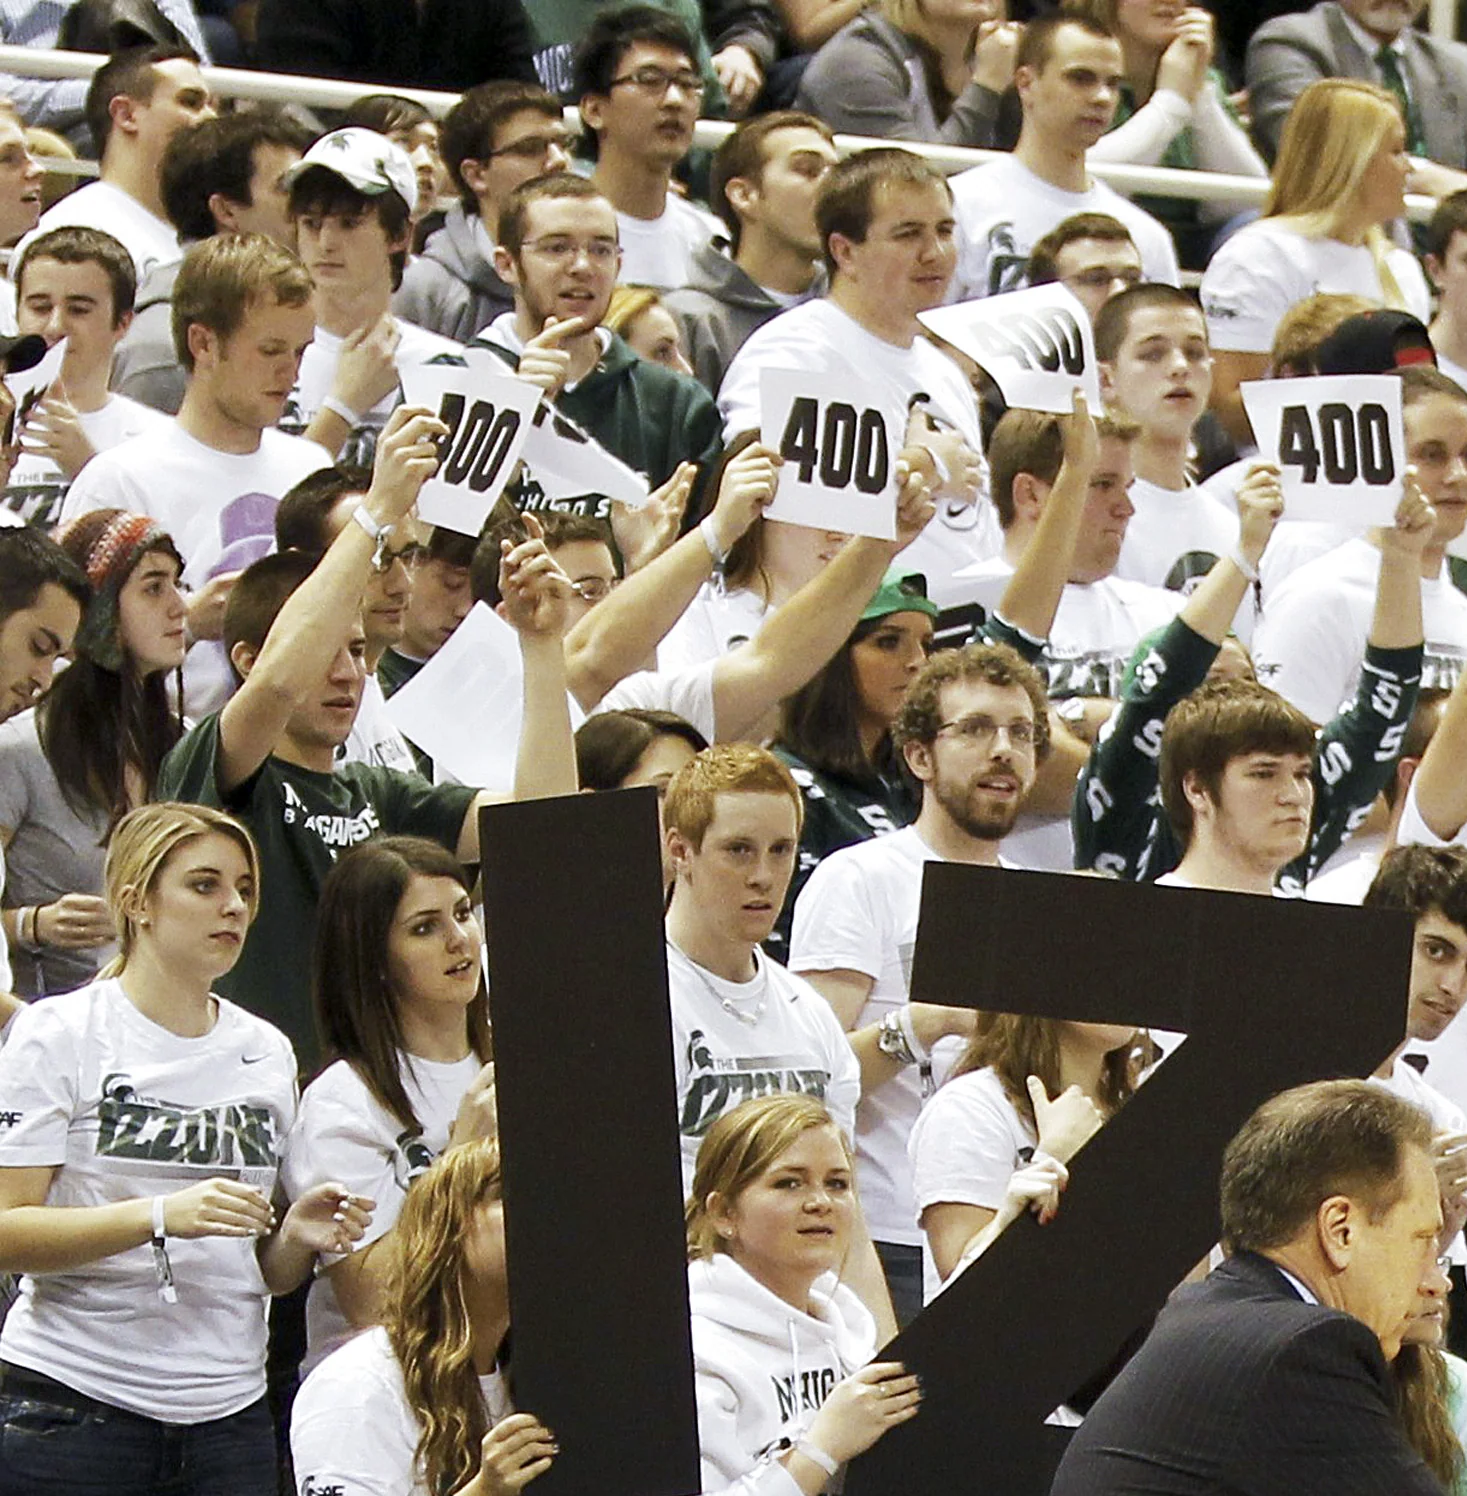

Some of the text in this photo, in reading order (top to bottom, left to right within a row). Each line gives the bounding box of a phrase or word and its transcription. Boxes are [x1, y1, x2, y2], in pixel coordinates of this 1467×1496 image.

[779, 396, 889, 495] 400
[1279, 403, 1396, 486] 400
[0, 1110, 23, 1128] AF
